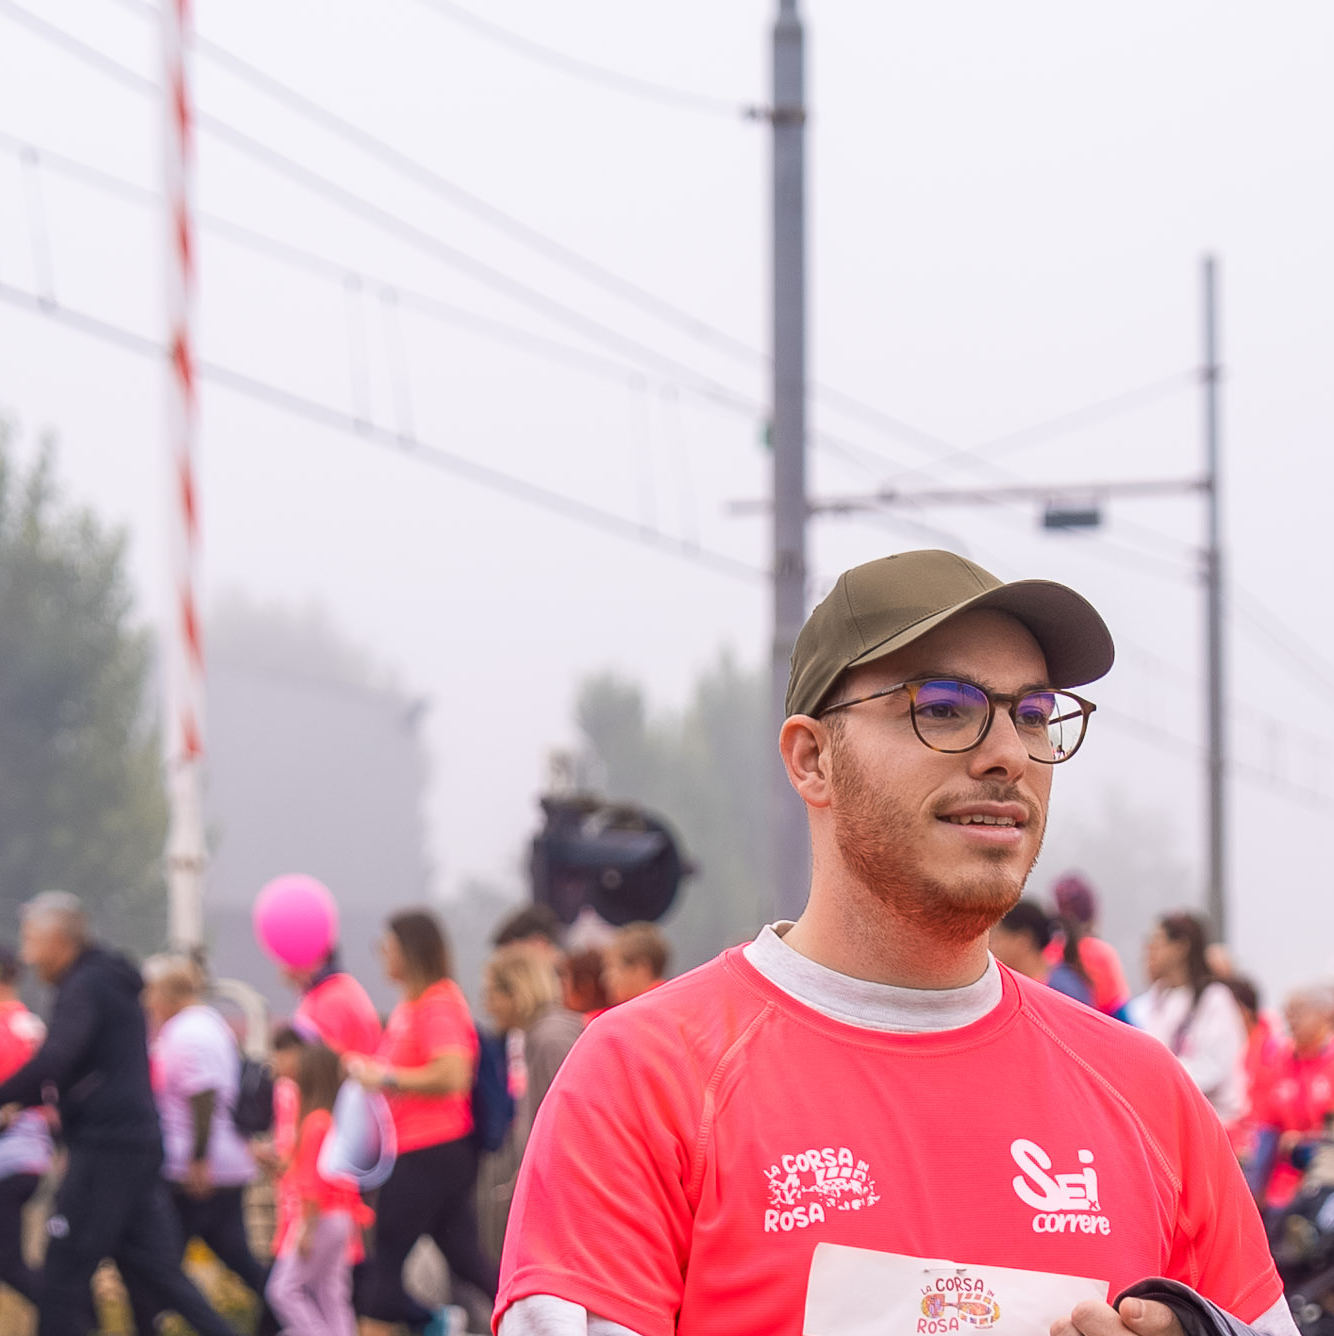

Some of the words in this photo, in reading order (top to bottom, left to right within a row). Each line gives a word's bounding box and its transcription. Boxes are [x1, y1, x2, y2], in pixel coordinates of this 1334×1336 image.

[763, 1165, 781, 1179] LA
[781, 1147, 854, 1173] CORSA
[857, 1160, 870, 1172] IN
[764, 1202, 825, 1232] ROSA
[1032, 1213, 1111, 1235] correre
[935, 1276, 984, 1292] CORSA
[917, 1317, 959, 1334] ROSA
